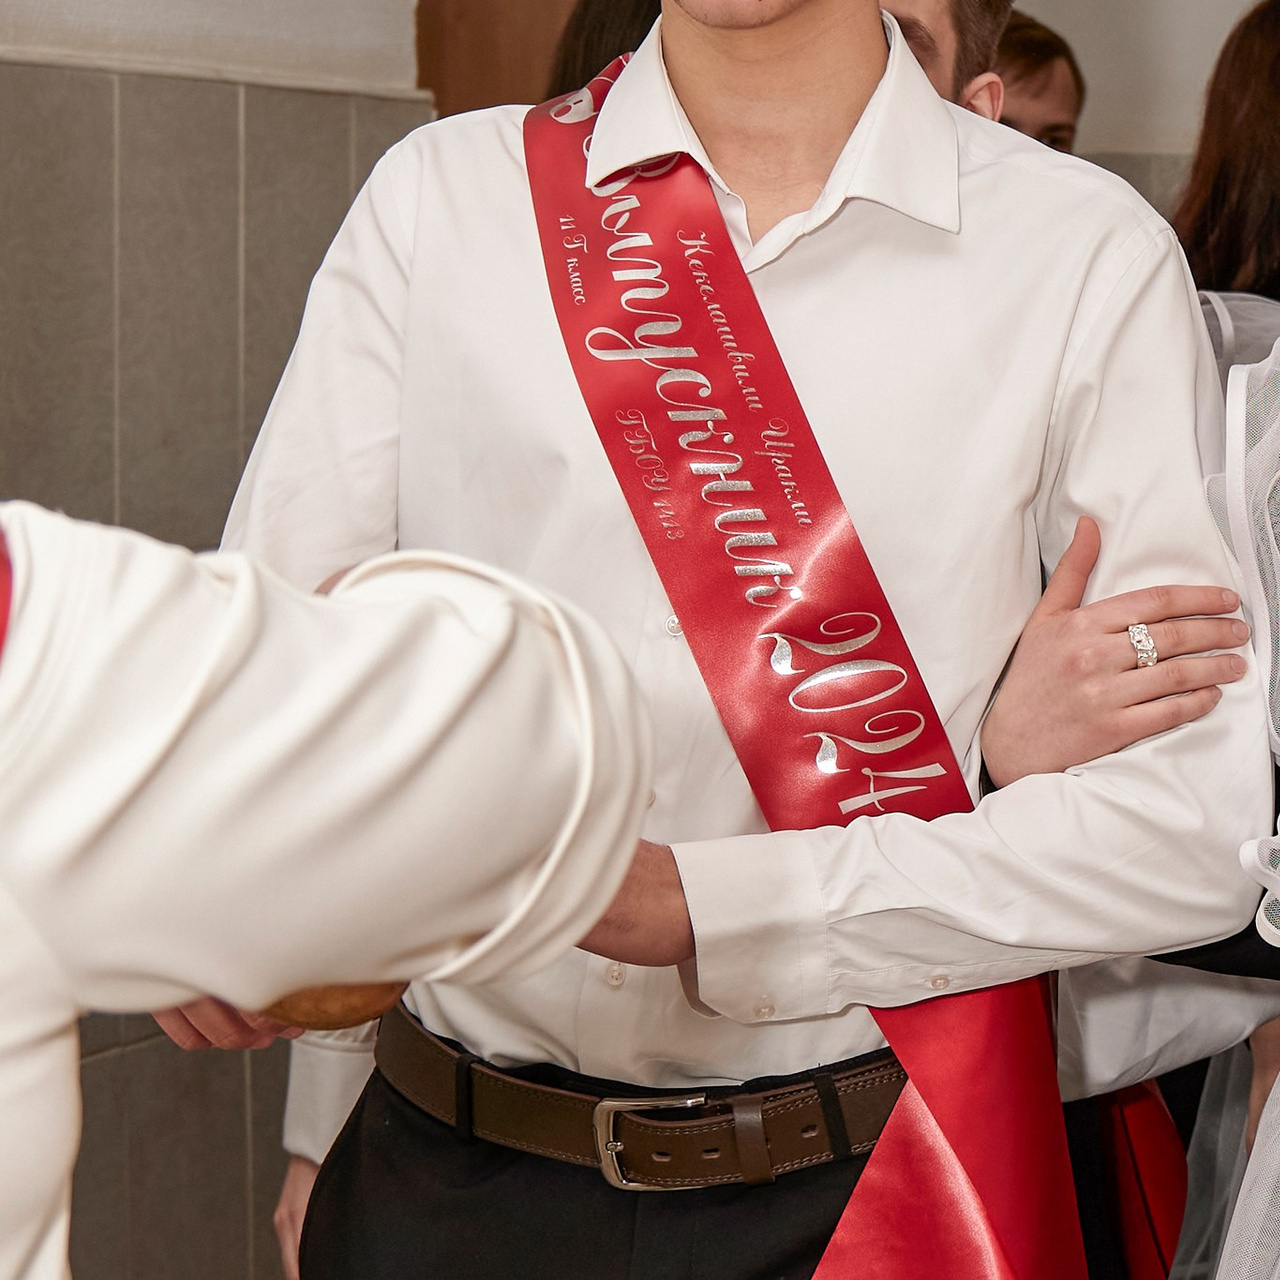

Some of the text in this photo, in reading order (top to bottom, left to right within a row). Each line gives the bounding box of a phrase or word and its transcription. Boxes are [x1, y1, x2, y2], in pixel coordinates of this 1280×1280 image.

[559, 215, 589, 307] 11 Г класс
[614, 408, 672, 491] ГБОУ
[754, 417, 813, 528] Иракли
[757, 611, 948, 815] 2024
